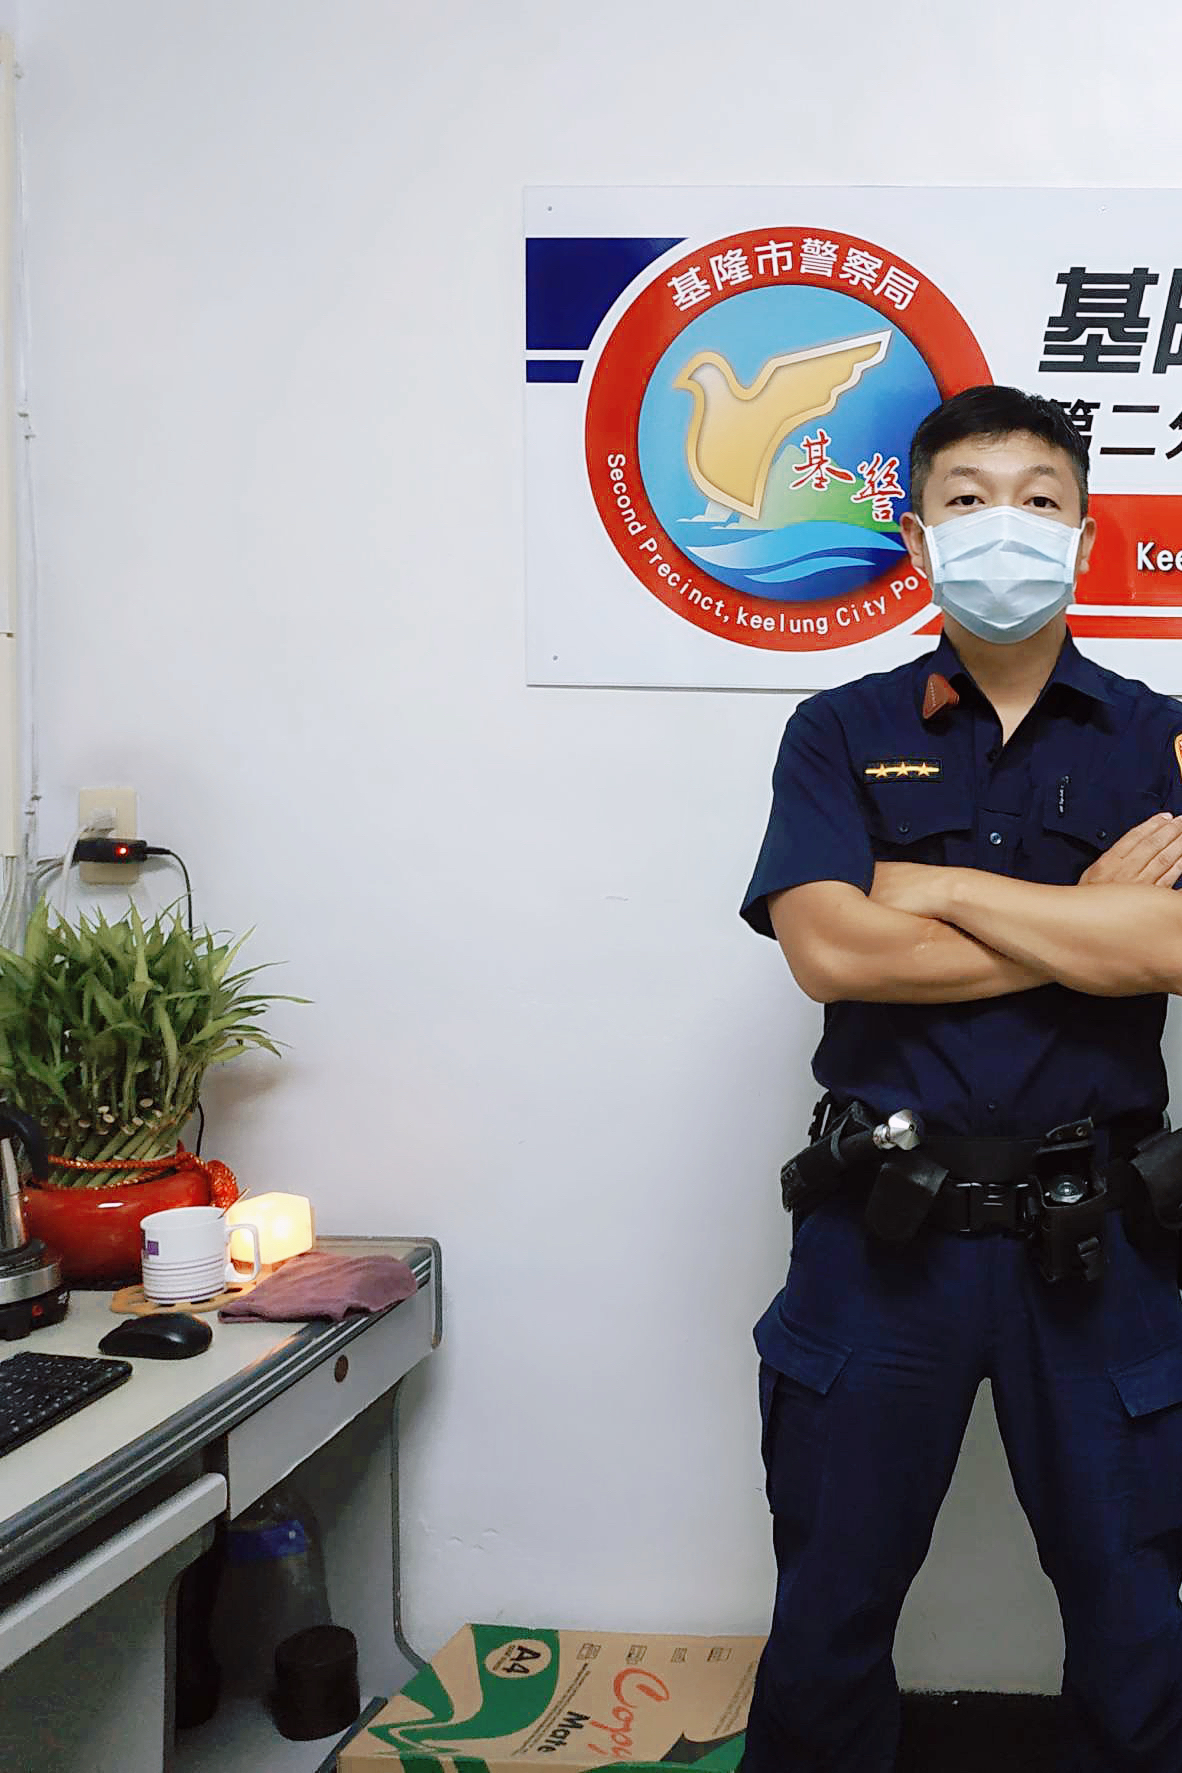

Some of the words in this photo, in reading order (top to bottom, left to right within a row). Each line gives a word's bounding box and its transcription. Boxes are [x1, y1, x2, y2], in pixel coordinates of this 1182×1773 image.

[667, 237, 920, 311] 基隆市警察局
[607, 453, 647, 536] Second
[638, 537, 730, 623] Precinct,
[736, 606, 829, 635] keelung
[835, 595, 887, 627] City
[502, 1645, 541, 1675] A4
[538, 1711, 591, 1753] Mate
